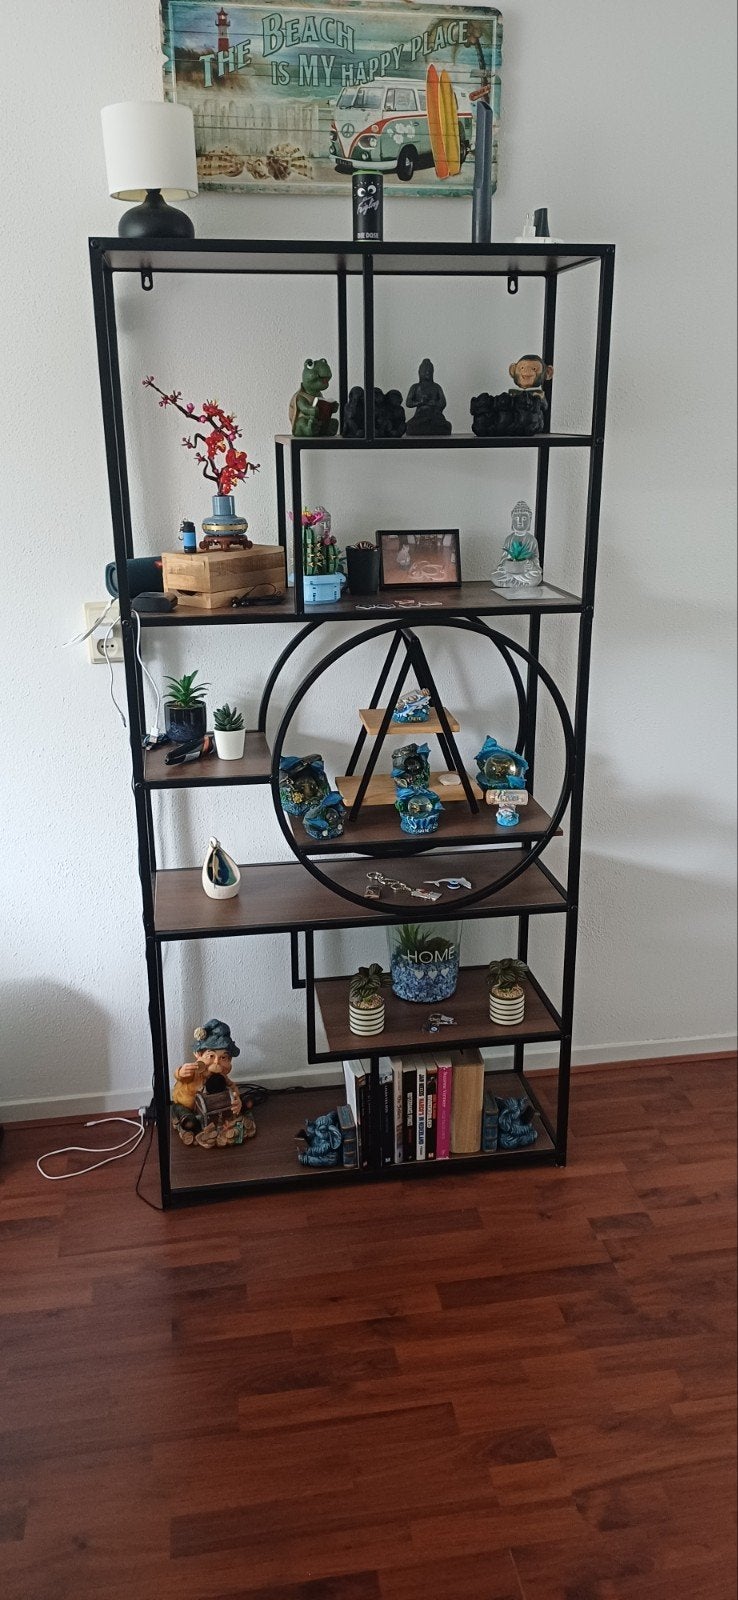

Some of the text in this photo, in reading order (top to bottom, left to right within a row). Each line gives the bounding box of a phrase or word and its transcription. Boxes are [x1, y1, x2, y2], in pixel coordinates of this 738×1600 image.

[199, 13, 354, 88] THE BEACH
[271, 20, 468, 88] IS MY HAPPY PLACE
[407, 945, 455, 964] HOME
